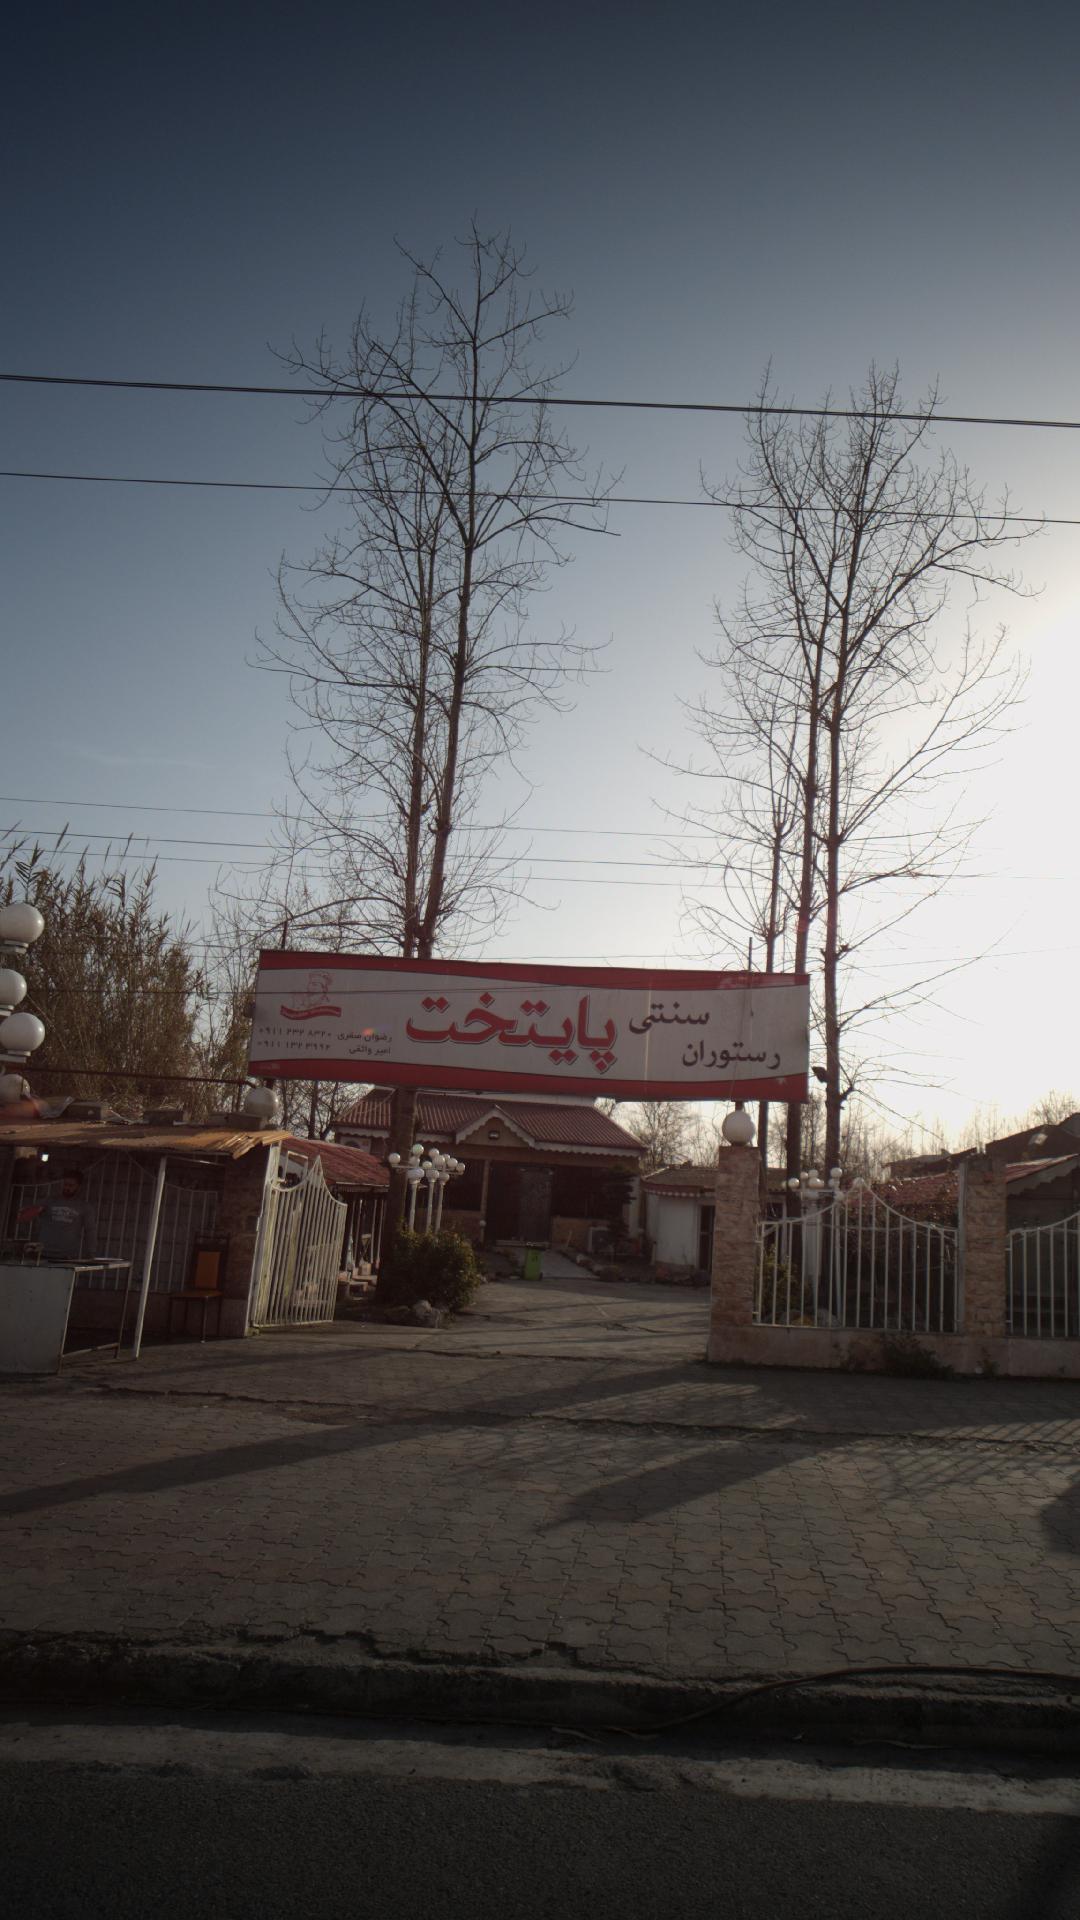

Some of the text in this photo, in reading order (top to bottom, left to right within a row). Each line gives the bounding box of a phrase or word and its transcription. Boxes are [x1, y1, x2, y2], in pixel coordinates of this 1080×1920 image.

[406, 991, 618, 1075] پایتخت
[629, 1002, 709, 1034] سنتی
[680, 1040, 780, 1069] رستوران
